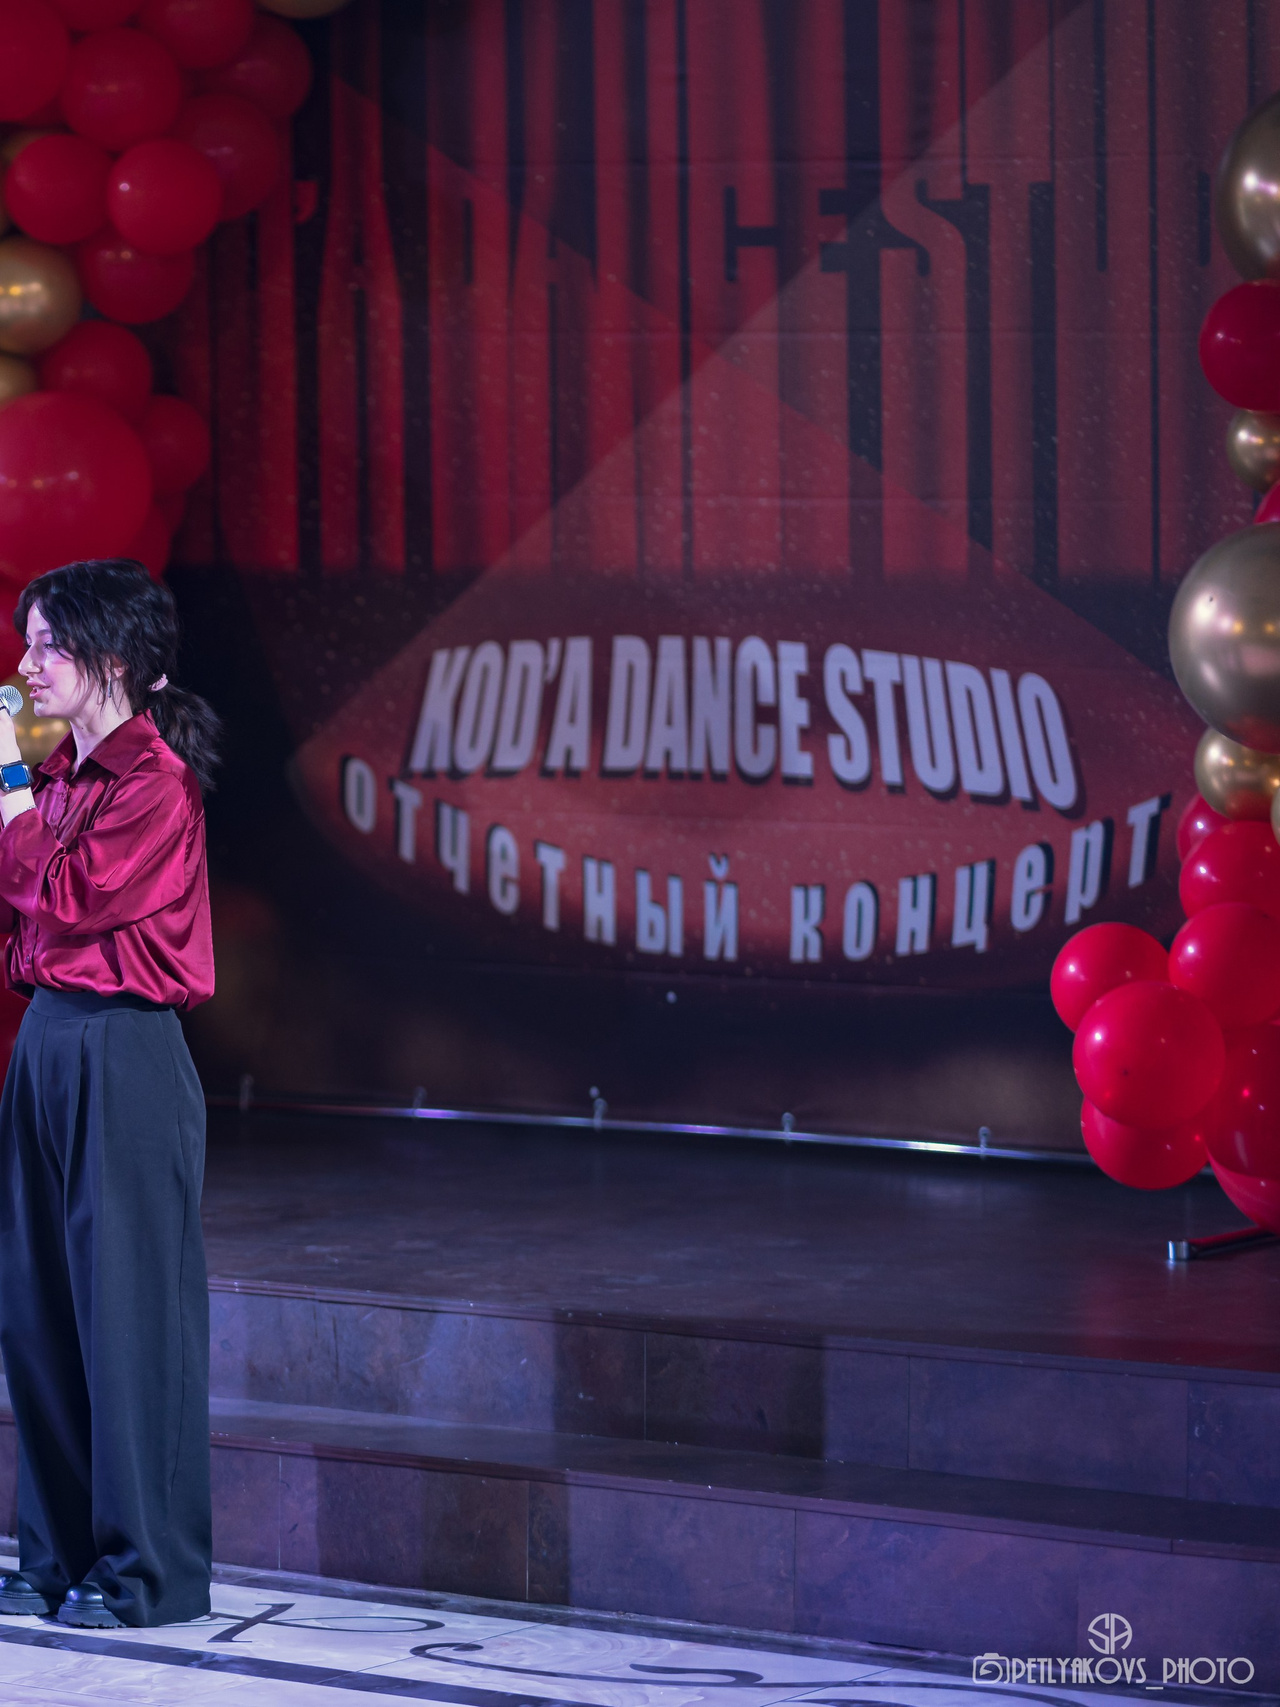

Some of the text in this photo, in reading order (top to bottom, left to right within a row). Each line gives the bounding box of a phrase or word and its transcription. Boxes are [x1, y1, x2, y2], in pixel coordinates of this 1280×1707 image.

[408, 634, 1079, 812] KOD'A DANCE STUDIO
[342, 758, 1167, 964] отчетный концерт
